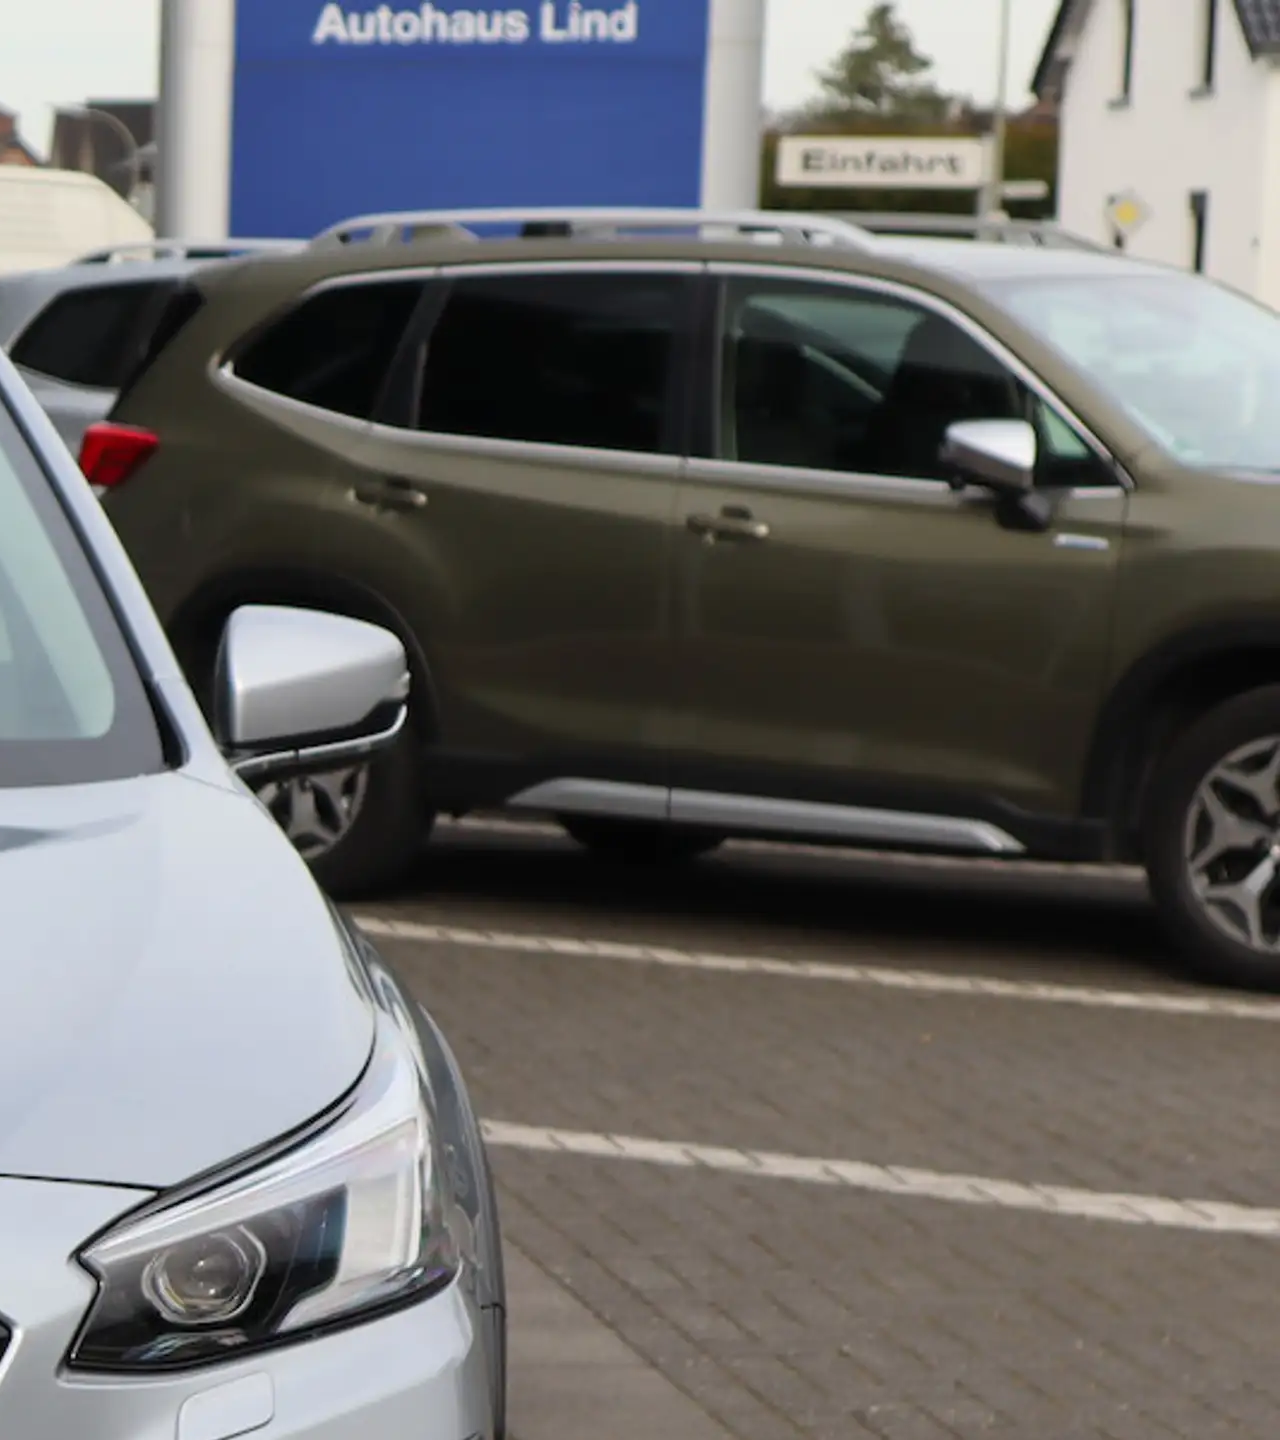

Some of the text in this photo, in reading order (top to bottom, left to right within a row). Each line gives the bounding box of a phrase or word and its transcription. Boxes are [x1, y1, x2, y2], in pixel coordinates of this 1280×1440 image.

[312, 1, 637, 43] Autohaus Lind
[801, 149, 961, 173] Einfahrt
